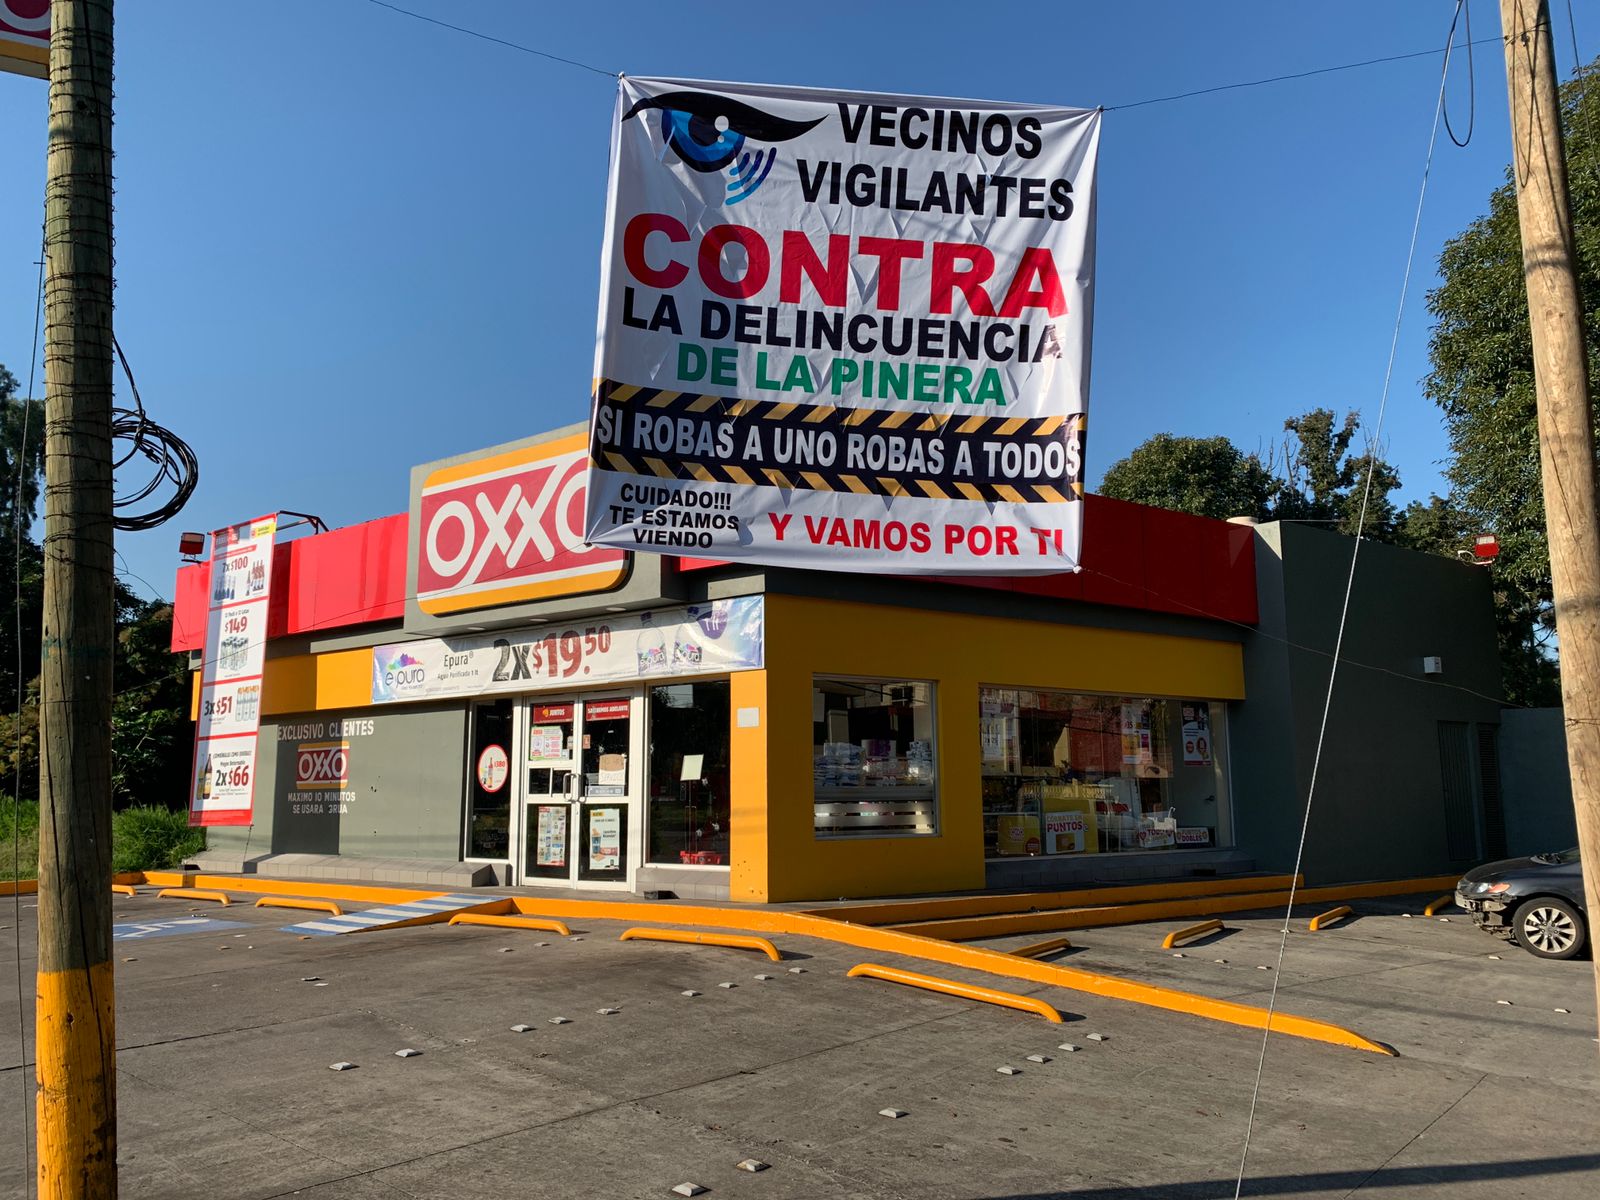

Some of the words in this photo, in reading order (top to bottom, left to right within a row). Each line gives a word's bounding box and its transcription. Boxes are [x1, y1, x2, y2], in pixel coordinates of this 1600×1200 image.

[837, 102, 1043, 160] VECINOS
[796, 158, 1074, 221] VIGILANTES
[623, 213, 1069, 319] CONTRA
[622, 286, 683, 336] LA
[700, 299, 1063, 364] DELINCUENCIA
[677, 342, 739, 388] DE
[755, 351, 815, 394] LA
[831, 357, 1006, 406] PINERA
[596, 404, 623, 447] SI
[633, 412, 735, 459] ROBAS
[742, 425, 764, 462] A
[773, 427, 838, 467] UNO
[846, 433, 945, 475] ROBAS
[953, 440, 974, 477] A
[982, 438, 1081, 479] TODOS
[620, 483, 731, 511] CUIDADO!!!
[426, 468, 596, 580] OXXO
[609, 504, 635, 526] TE
[641, 509, 740, 531] ESTAMOS
[633, 528, 713, 549] VIENDO
[767, 512, 793, 541] Y
[804, 515, 932, 554] VAMOS
[944, 523, 1019, 556] POR
[1030, 526, 1064, 557] TI
[224, 616, 248, 633] $149
[216, 696, 233, 715] $51
[278, 722, 324, 741] EXCLUSIVO
[329, 719, 375, 738] CLIENTES
[215, 769, 228, 787] 2x
[228, 765, 249, 787] $66
[297, 751, 347, 781] OXXO
[288, 792, 313, 802] MAXIMO
[324, 791, 356, 802] MINUTOS
[292, 804, 301, 814] SE
[301, 804, 324, 814] USARA
[1047, 821, 1083, 833] PUNTOS
